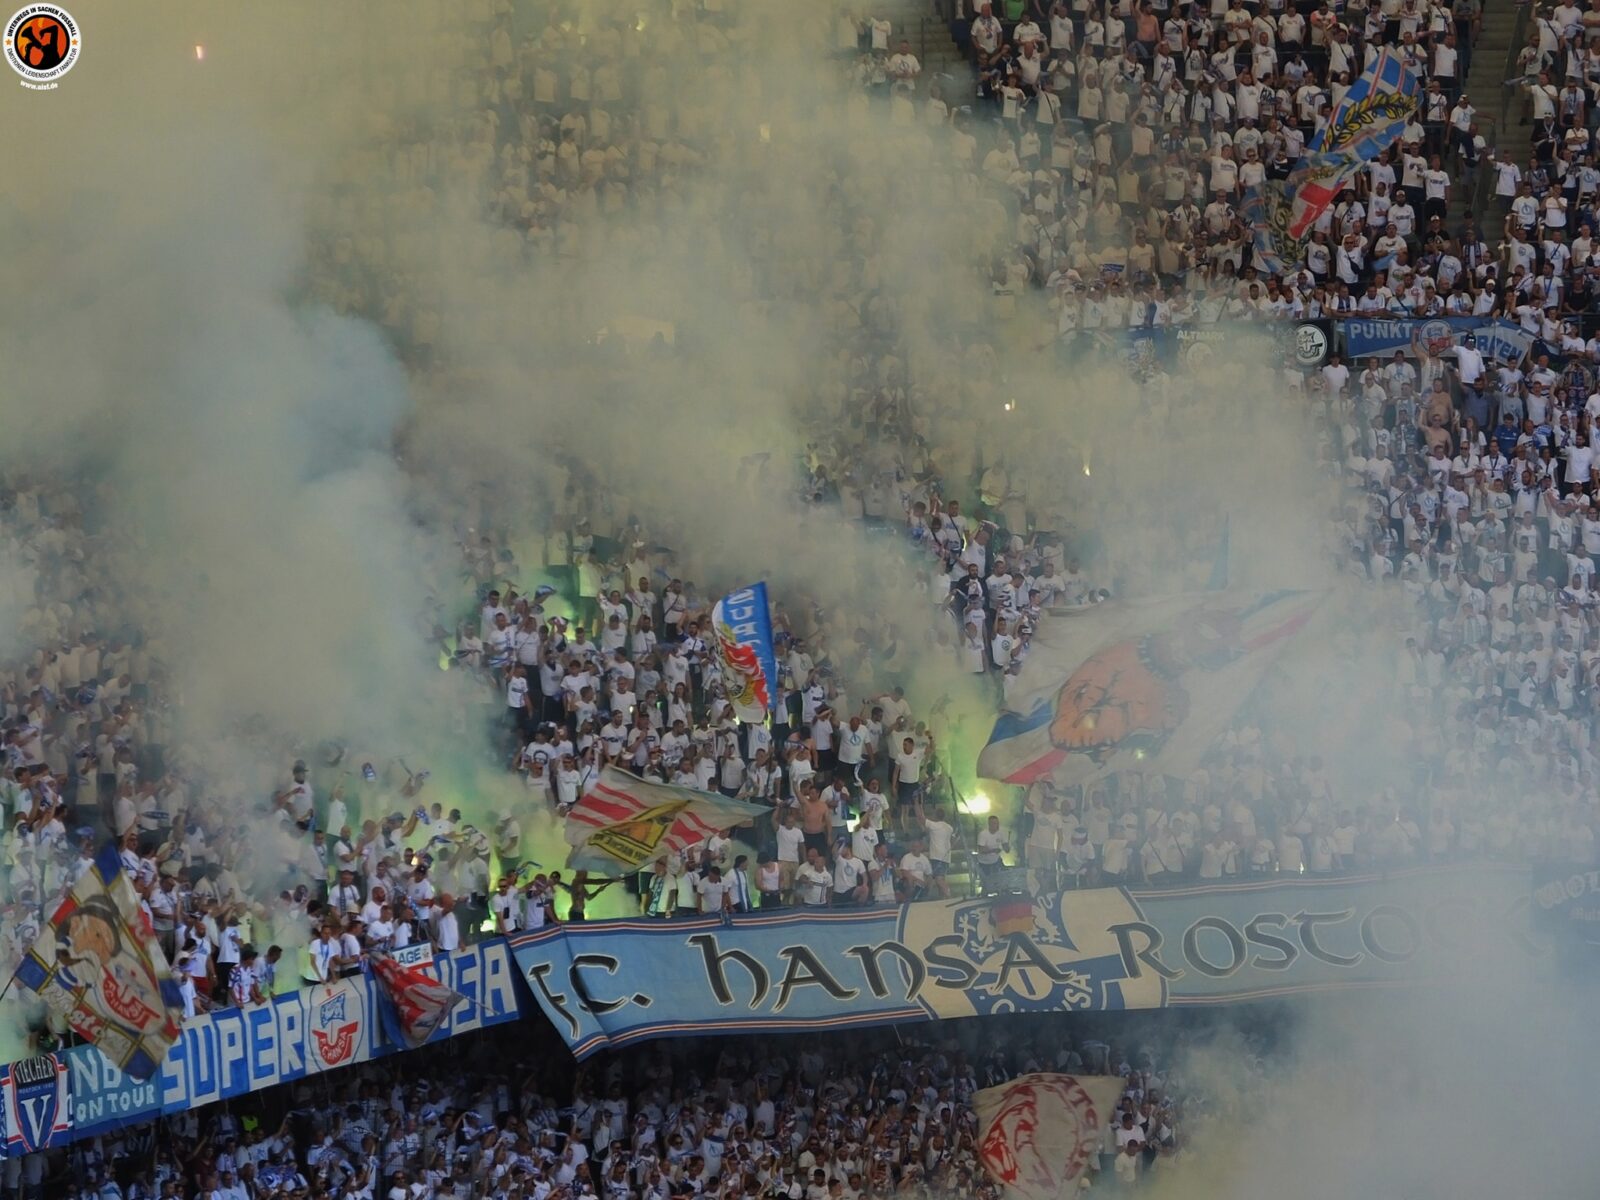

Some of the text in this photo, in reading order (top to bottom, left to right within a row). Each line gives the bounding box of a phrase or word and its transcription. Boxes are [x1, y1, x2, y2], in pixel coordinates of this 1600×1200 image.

[1350, 322, 1414, 340] PUNKT
[15, 1055, 55, 1084] VIECHER
[161, 998, 305, 1110] SUPER
[21, 1094, 52, 1148] V
[76, 1084, 156, 1122] ON TOUR
